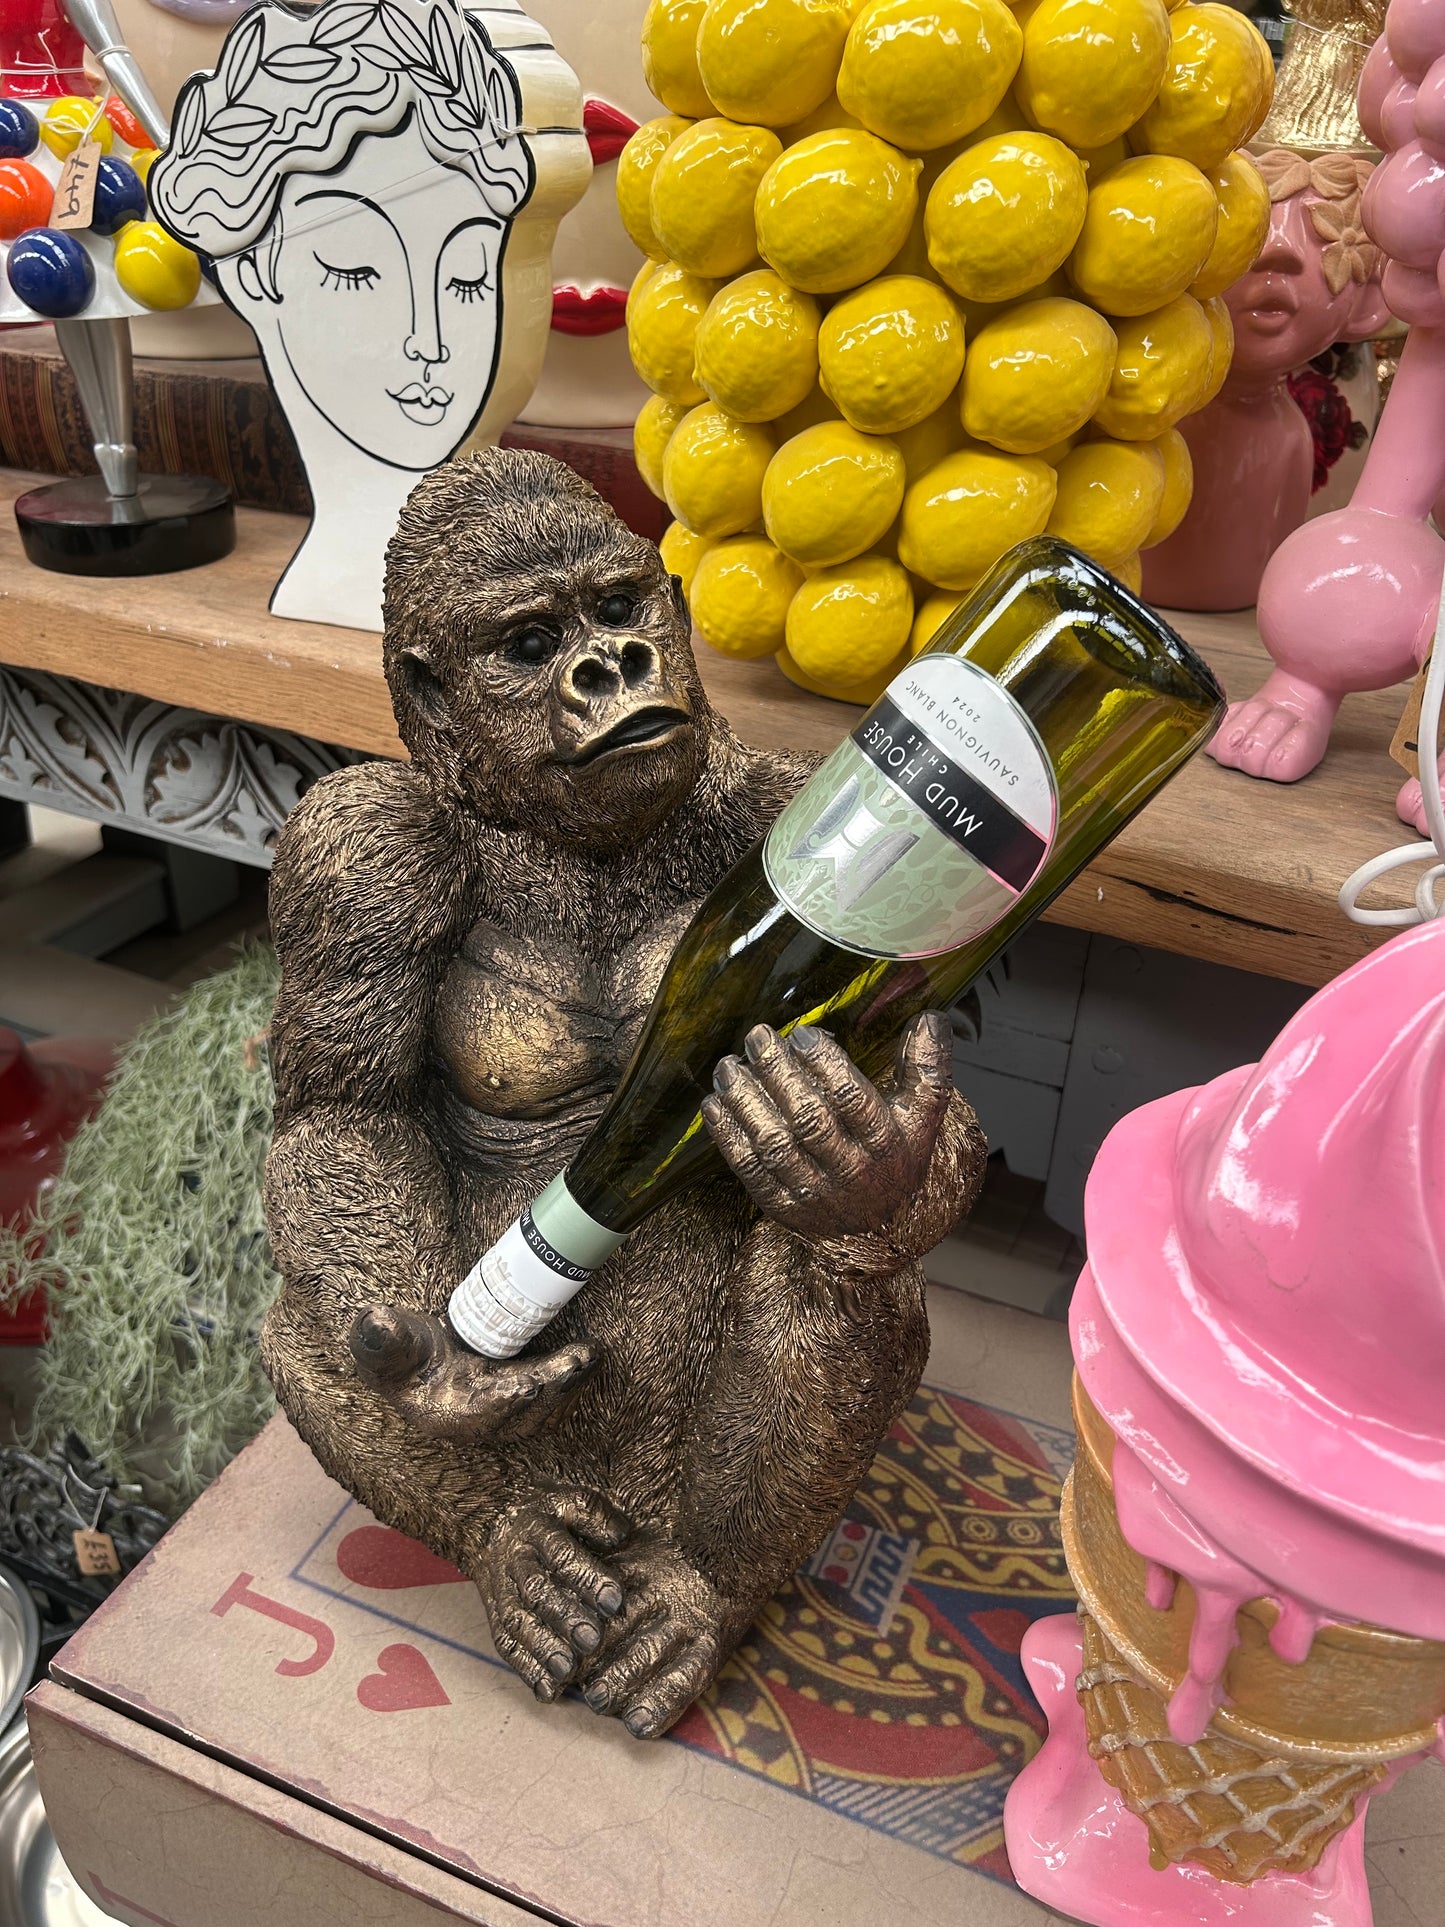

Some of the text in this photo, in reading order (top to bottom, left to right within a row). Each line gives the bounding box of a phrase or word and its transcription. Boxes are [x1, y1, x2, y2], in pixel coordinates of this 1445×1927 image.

[57, 154, 89, 219] £49
[905, 680, 1019, 786] SAUVIGNON BLANC
[951, 696, 982, 723] 2024
[863, 720, 984, 838] MUD HOUSE
[906, 734, 948, 775] CHILE
[527, 1229, 566, 1270] HOUSE
[567, 1266, 594, 1279] MUD
[208, 1571, 336, 1678] J
